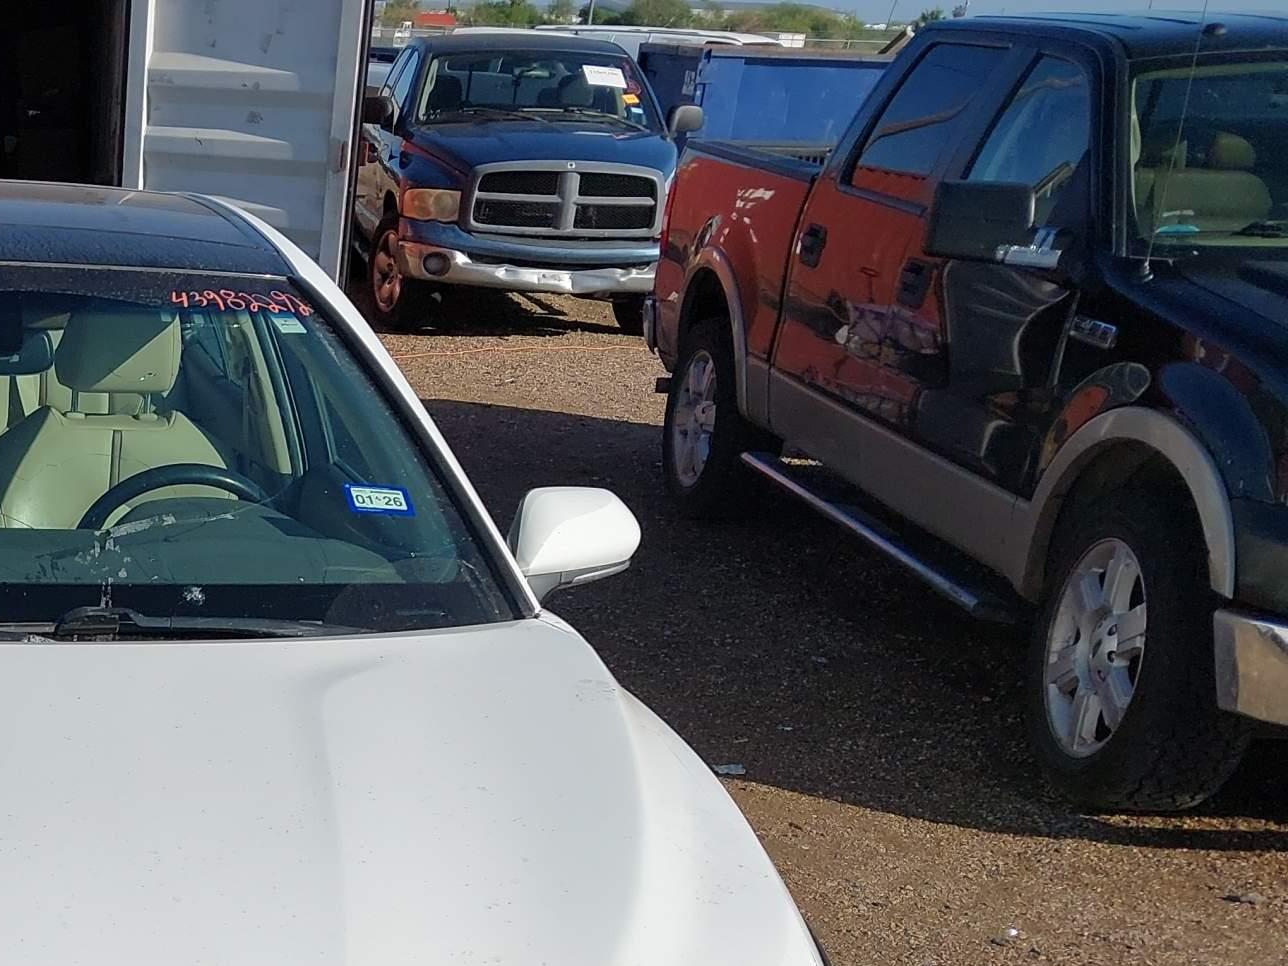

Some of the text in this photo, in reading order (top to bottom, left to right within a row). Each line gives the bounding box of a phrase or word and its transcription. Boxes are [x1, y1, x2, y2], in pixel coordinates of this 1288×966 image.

[171, 289, 314, 317] 43982292
[355, 494, 403, 507] 01 26
